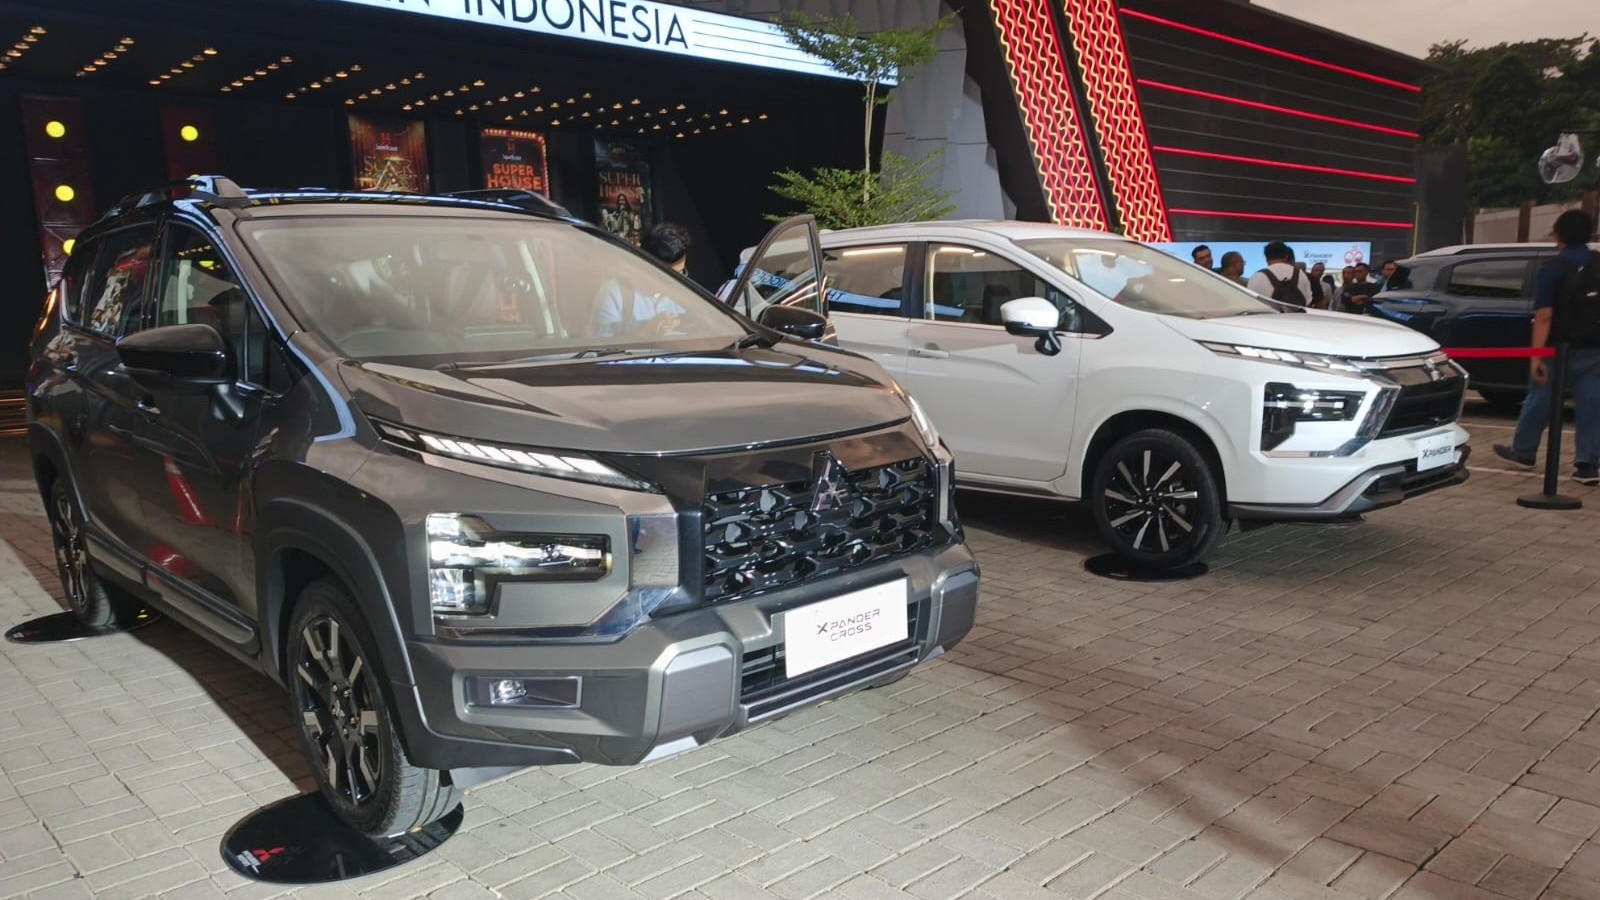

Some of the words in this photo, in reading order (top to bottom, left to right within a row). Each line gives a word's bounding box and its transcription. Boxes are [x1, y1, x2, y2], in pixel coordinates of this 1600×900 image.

[493, 163, 534, 176] SUPER
[487, 173, 542, 190] HOUSE
[599, 171, 641, 186] SUPER
[817, 608, 880, 635] XPANDER
[830, 622, 872, 642] CROSS
